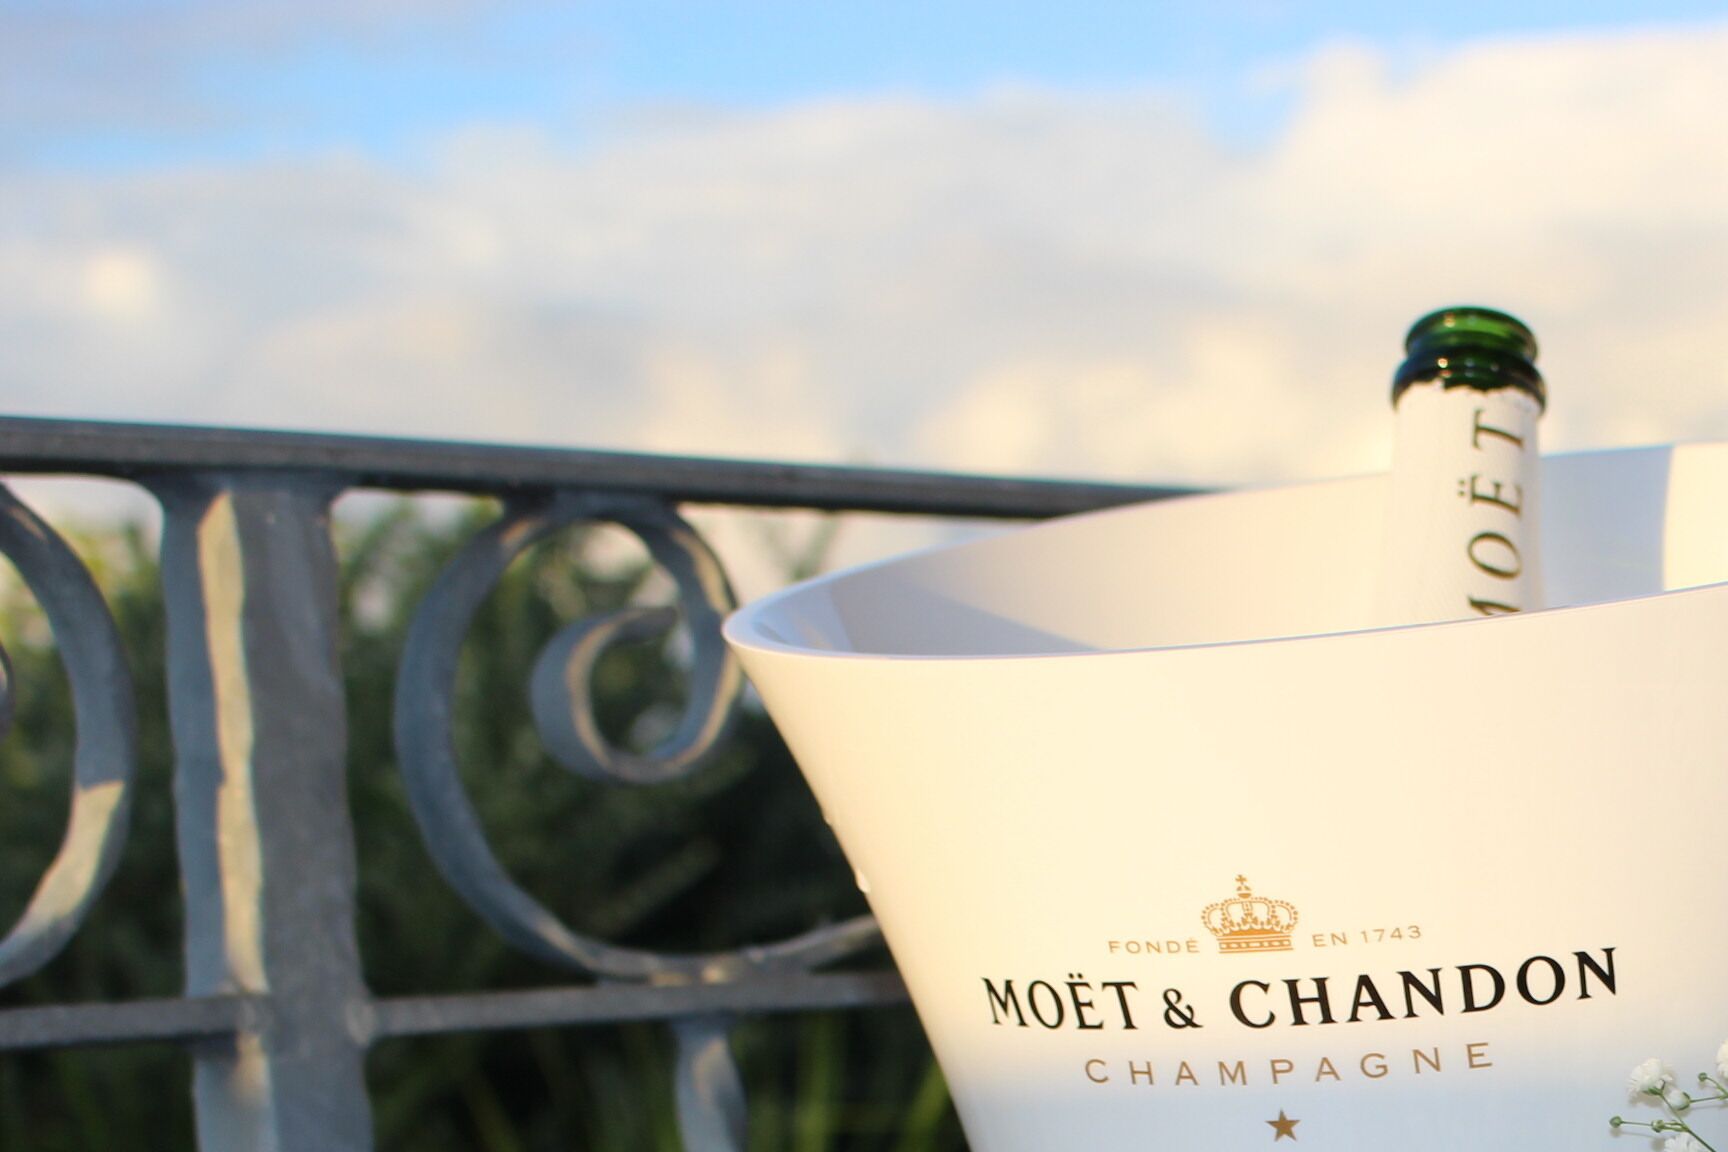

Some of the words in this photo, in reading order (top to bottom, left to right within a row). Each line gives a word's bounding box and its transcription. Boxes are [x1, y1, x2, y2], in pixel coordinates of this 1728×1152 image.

[1311, 929, 1348, 948] EN
[1361, 924, 1423, 945] 1743
[981, 972, 1140, 1031] MOËT
[1163, 987, 1204, 1029] &
[1228, 946, 1620, 1030] CHANDON
[1085, 1041, 1494, 1087] CHAMPAGNE
